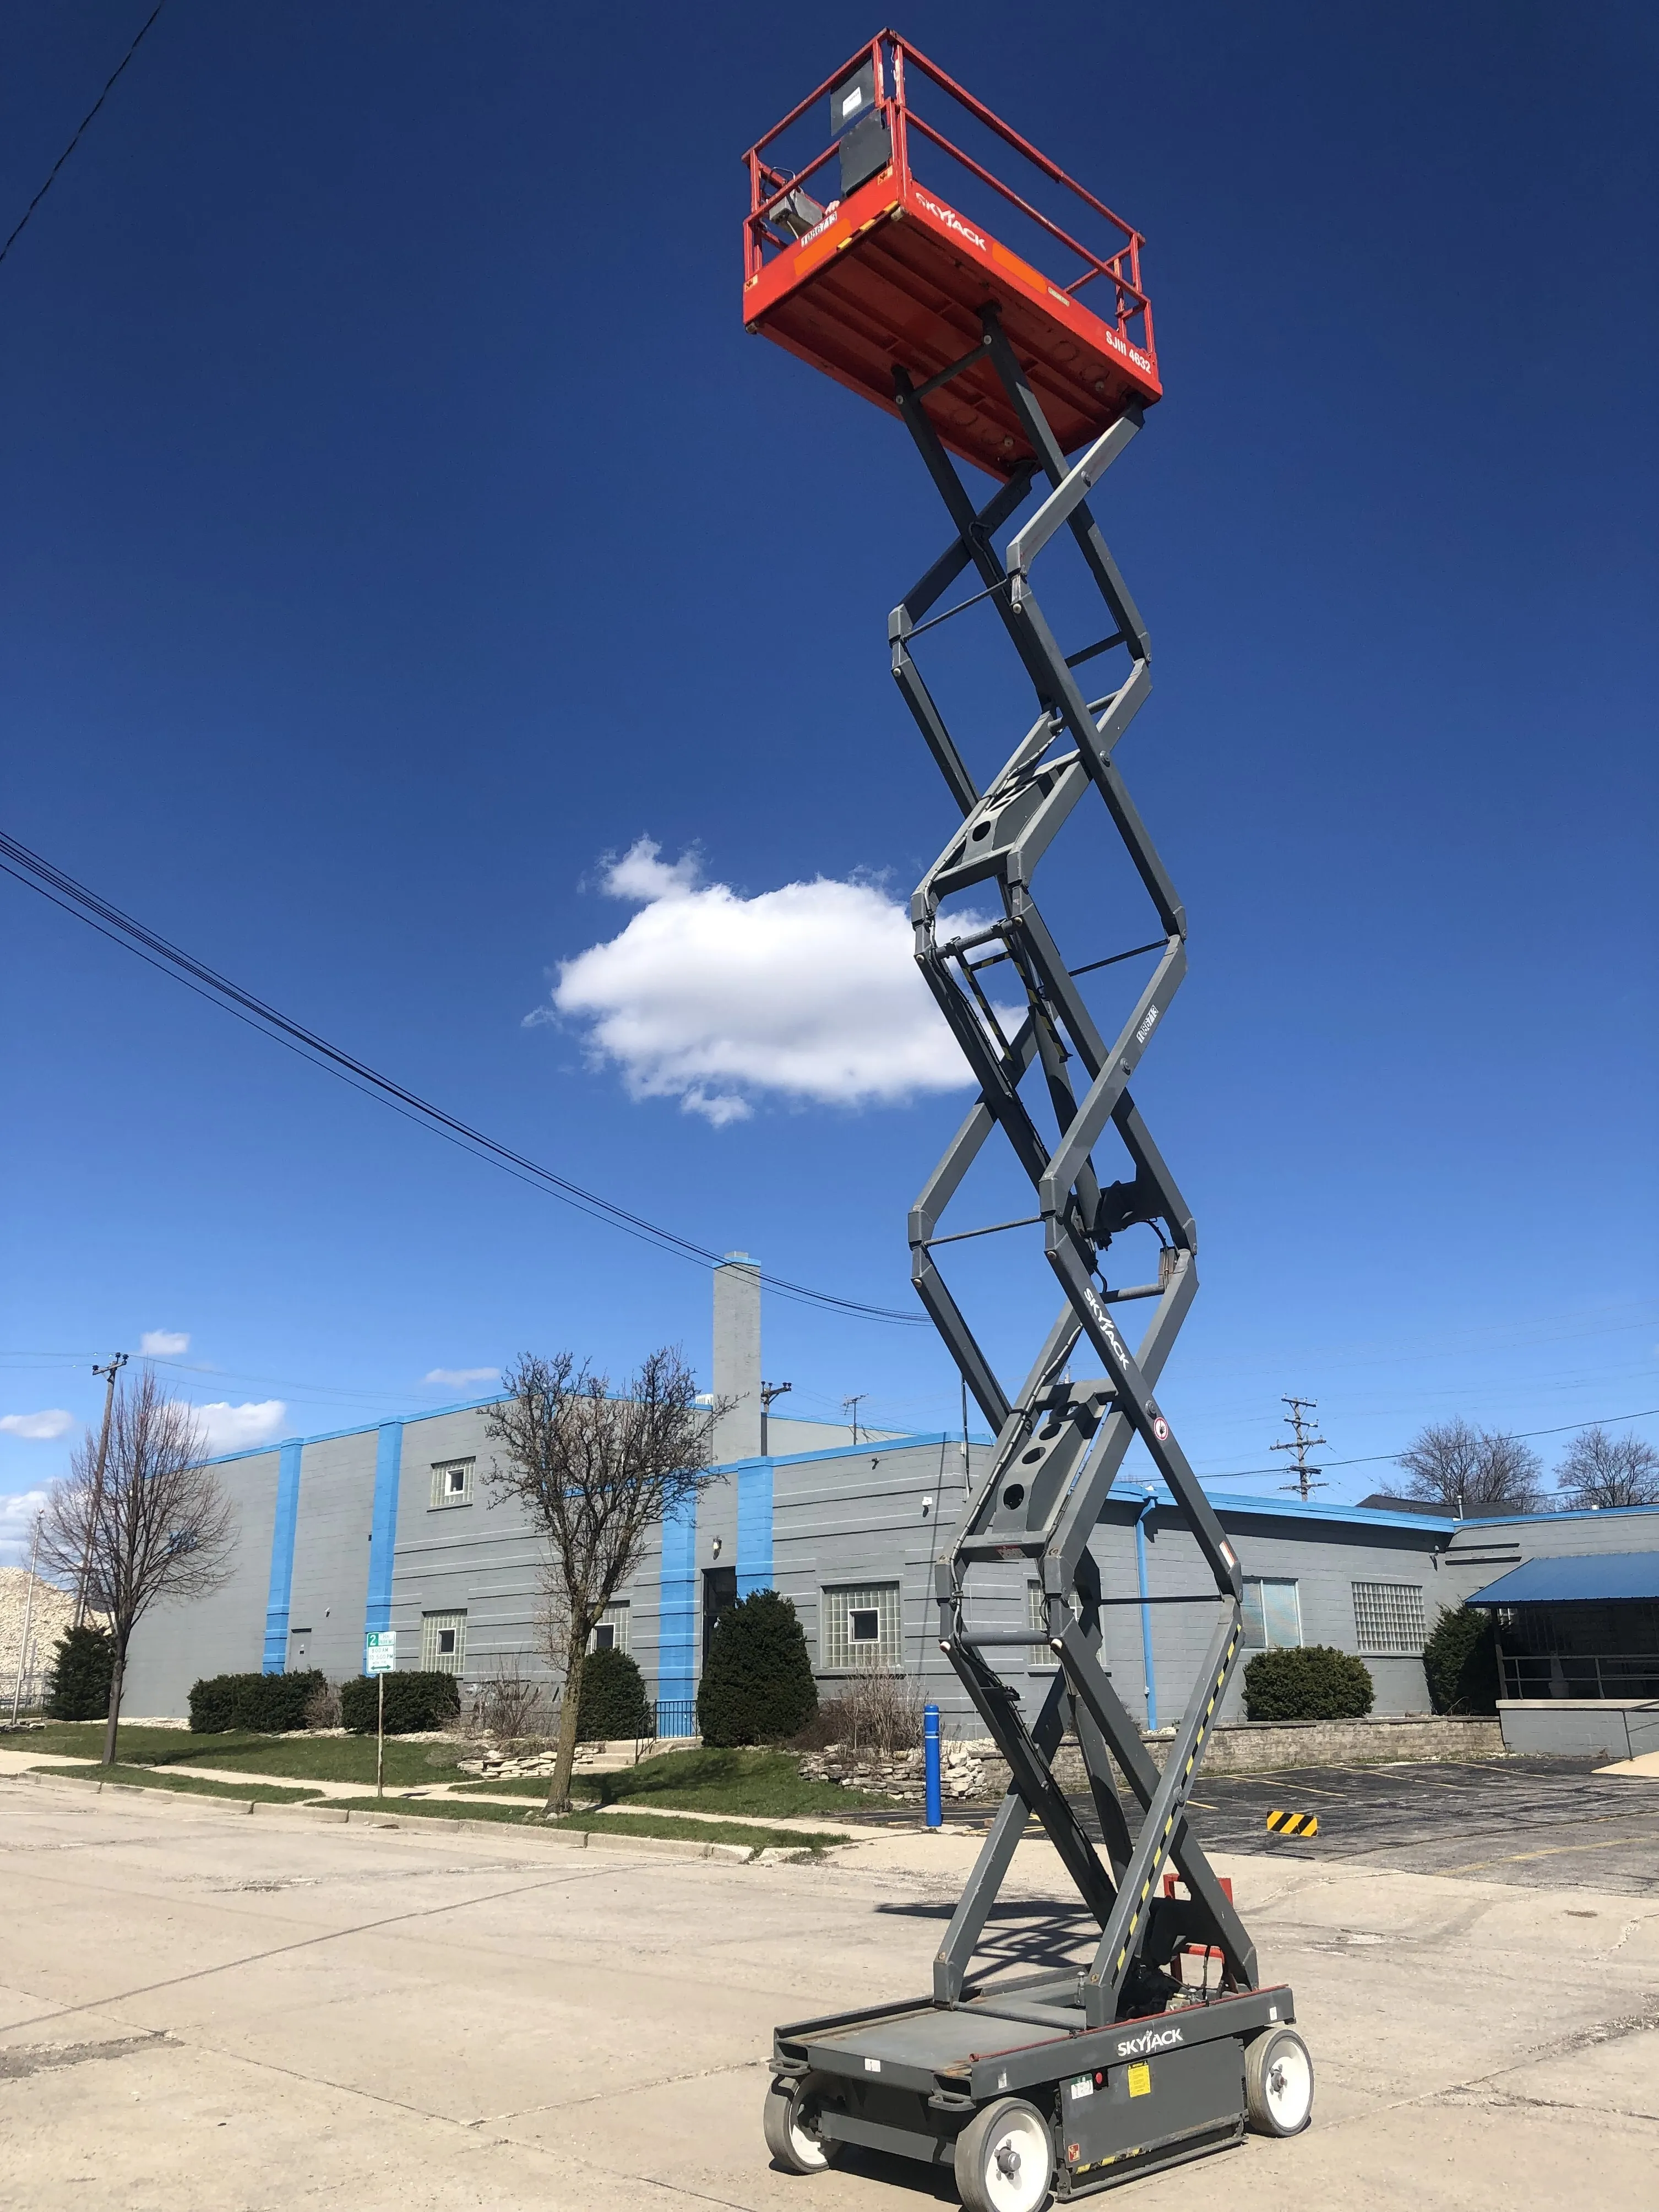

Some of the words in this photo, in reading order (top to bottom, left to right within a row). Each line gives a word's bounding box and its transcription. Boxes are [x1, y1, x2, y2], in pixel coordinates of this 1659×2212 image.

[802, 211, 836, 246] 1086713
[915, 192, 987, 251] SKYJACK
[1106, 330, 1127, 357] SJIII
[1129, 348, 1152, 374] 4632
[1138, 1006, 1158, 1041] 1086713
[1084, 1287, 1129, 1371] SKYJACK
[369, 1634, 376, 1645] 2
[1117, 2028, 1184, 2057] SKYJACK
